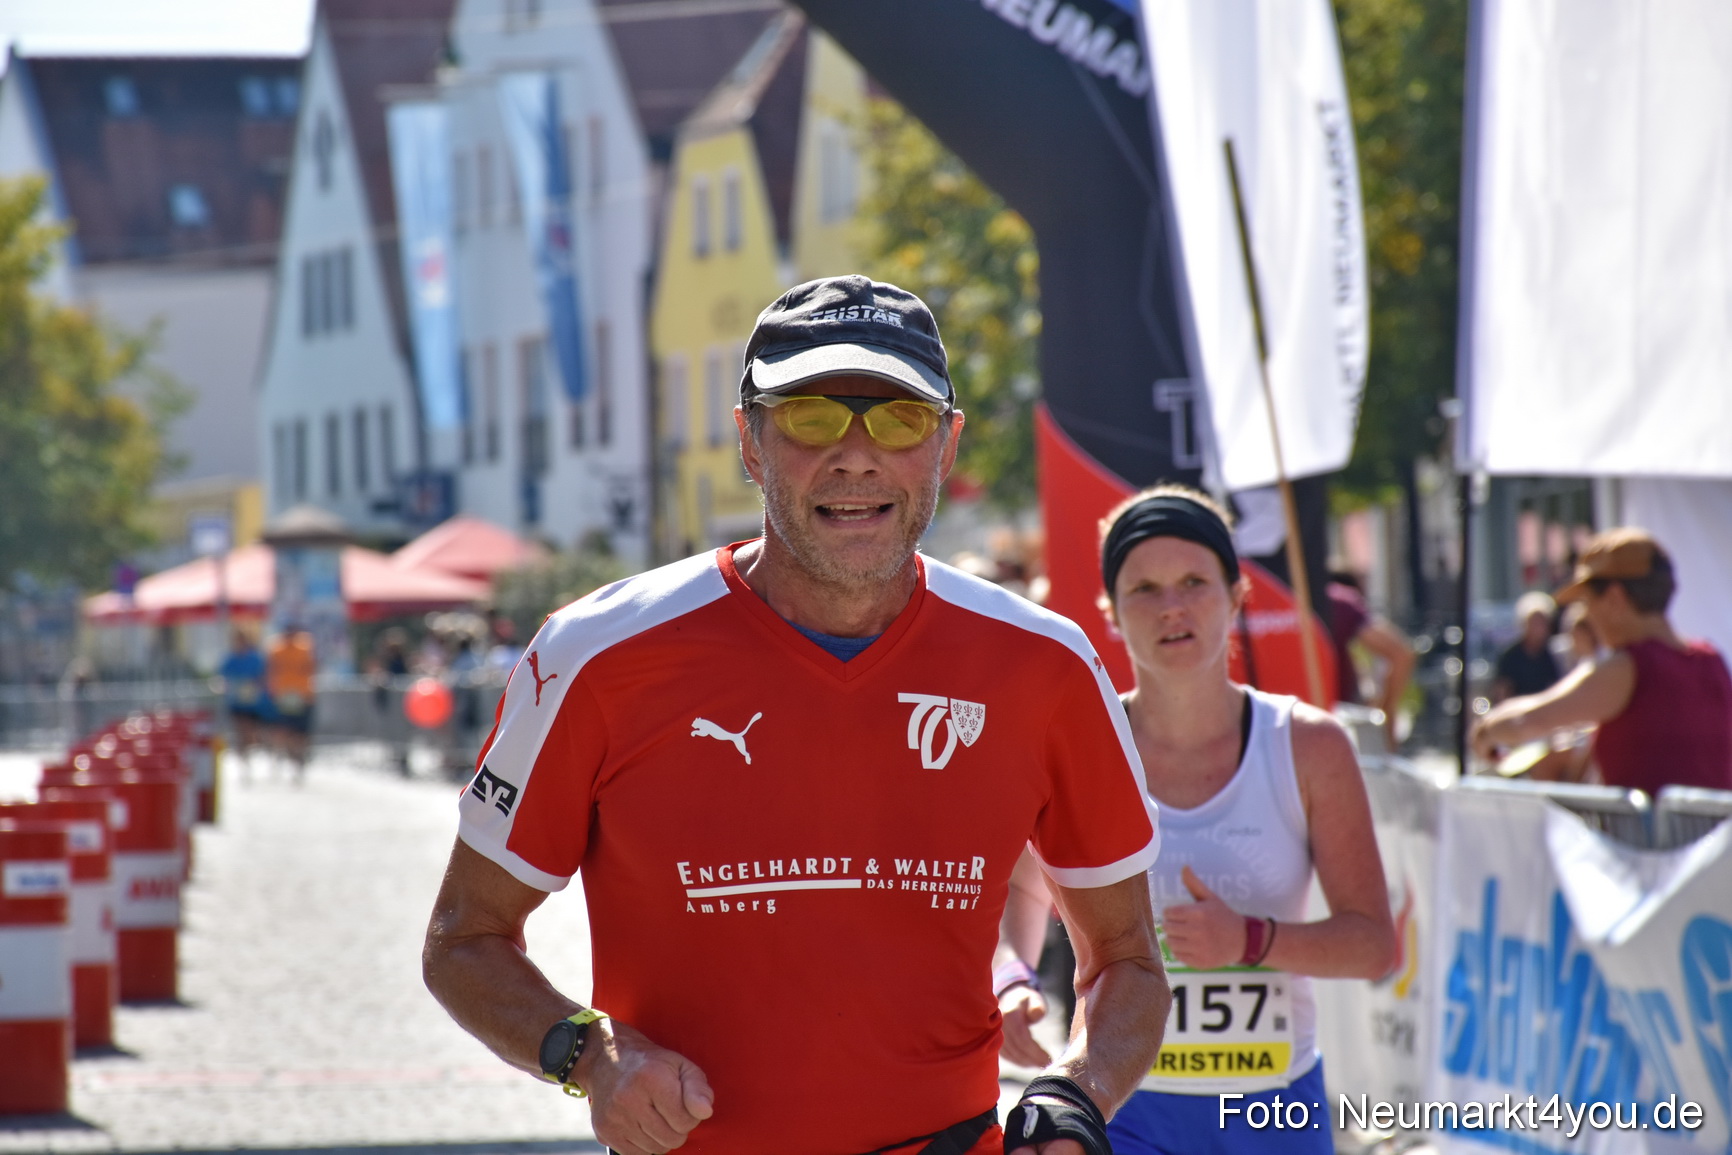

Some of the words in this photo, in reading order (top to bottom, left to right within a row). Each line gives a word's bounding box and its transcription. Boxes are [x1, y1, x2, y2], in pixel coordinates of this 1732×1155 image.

[677, 857, 852, 885] ENGELHARDT
[865, 858, 879, 875] &
[894, 856, 986, 880] WALTER
[867, 880, 893, 889] DAS
[901, 880, 982, 894] HERRENHAUS
[686, 899, 776, 914] Amberg
[931, 894, 979, 910] Lauf
[1153, 1051, 1274, 1072] RISTINA
